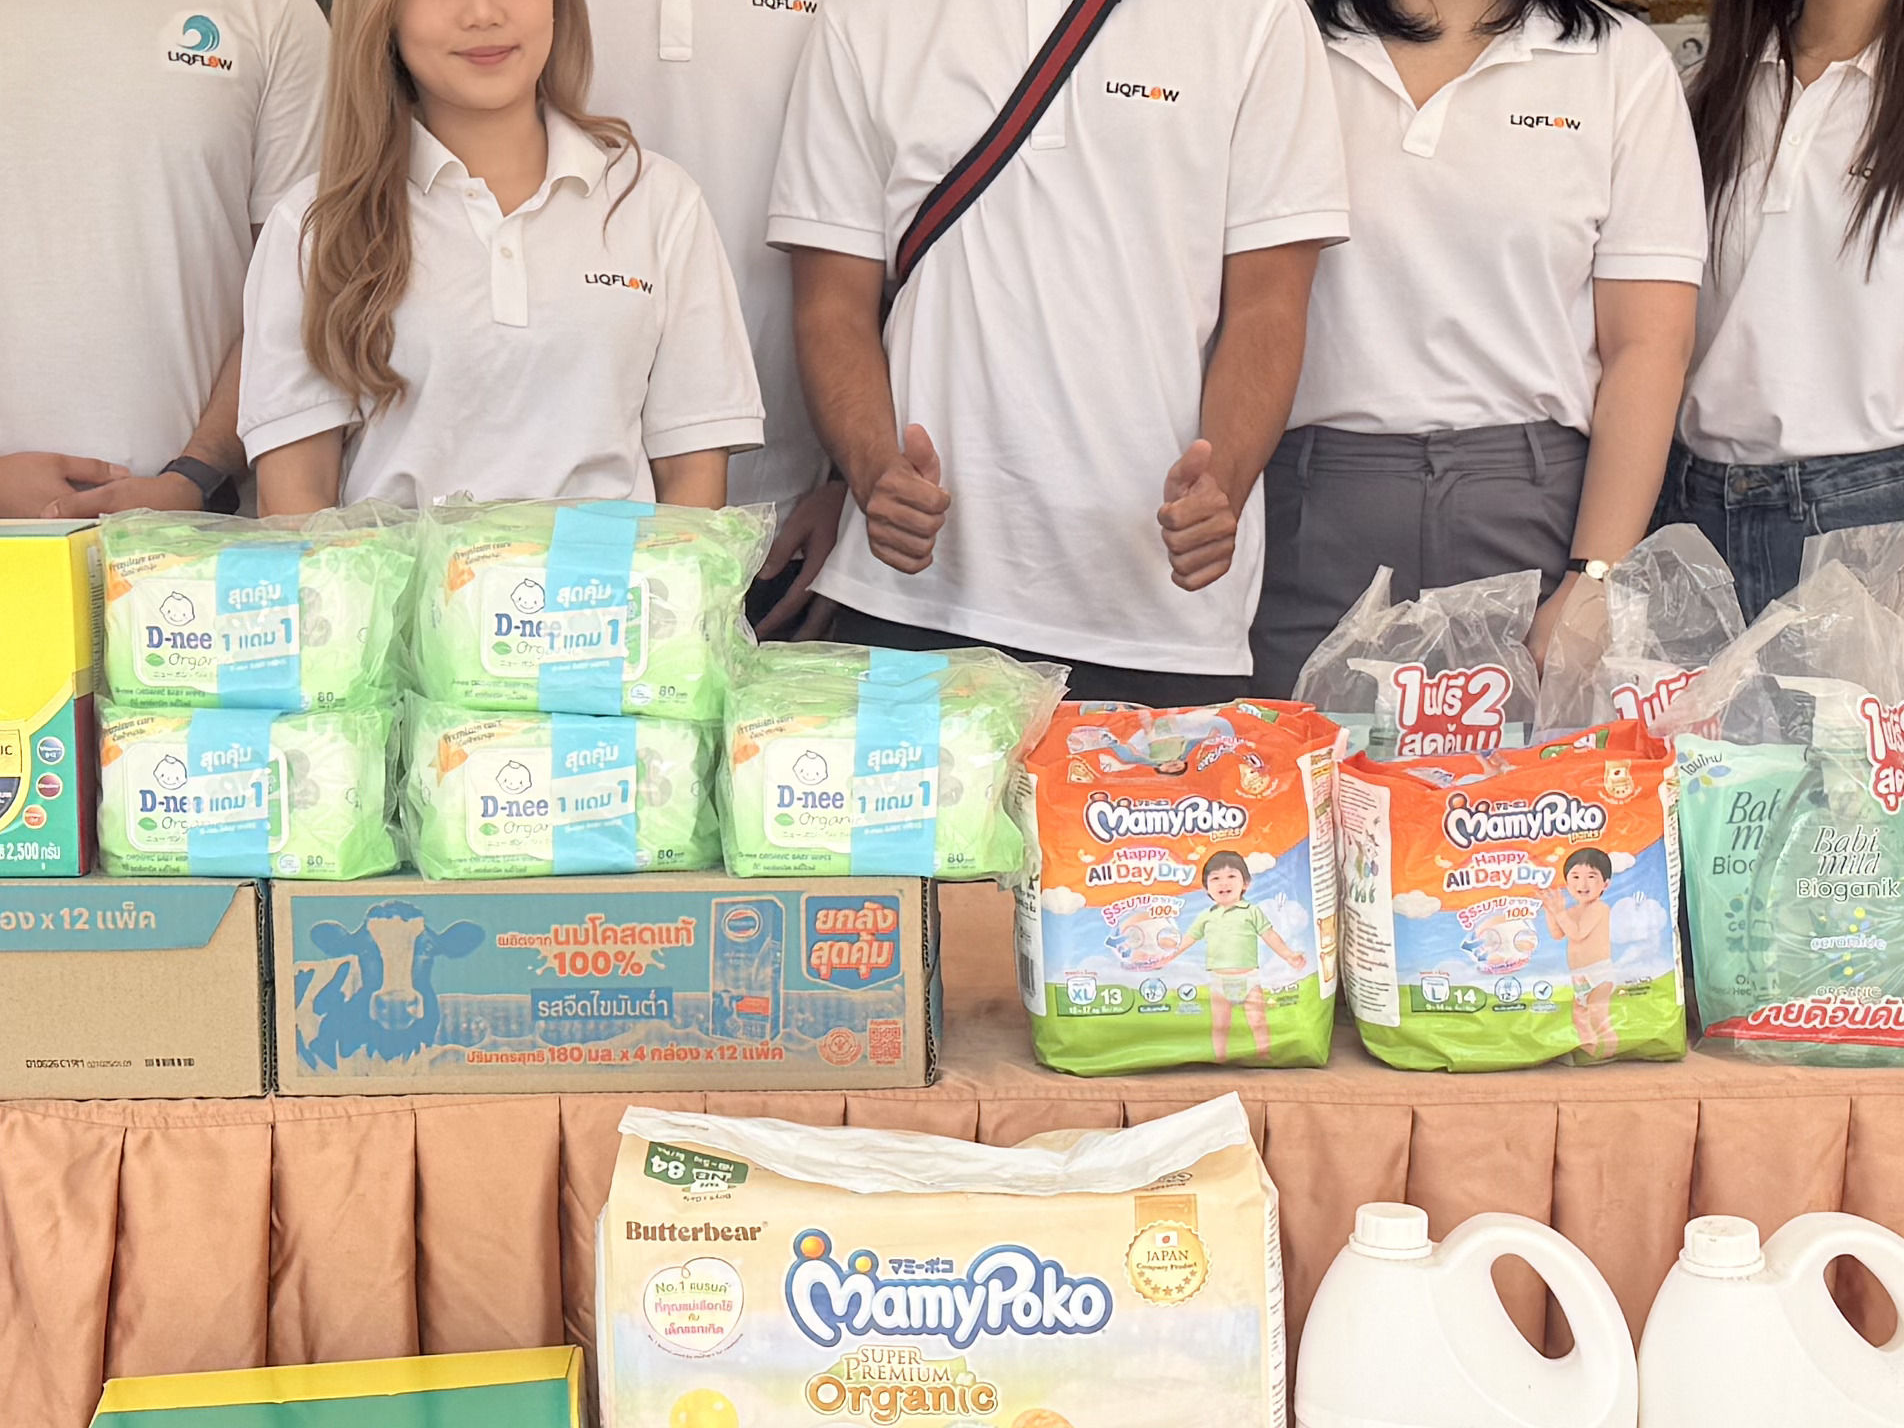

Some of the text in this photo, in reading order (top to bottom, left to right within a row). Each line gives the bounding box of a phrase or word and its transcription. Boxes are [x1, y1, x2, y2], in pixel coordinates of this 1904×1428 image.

[167, 51, 233, 71] LIQFLOW
[1106, 81, 1180, 102] LIQFLOW
[1510, 114, 1581, 131] LIQFLOW
[584, 273, 653, 295] LIQFLOW
[1085, 792, 1247, 841] MamyPoko
[1444, 792, 1606, 847] MamyPoko
[5, 840, 40, 863] 2,500
[1796, 877, 1901, 902] Bioganik
[59, 907, 89, 932] 12
[95, 900, 159, 933] แพ็ค
[624, 1220, 763, 1242] Butterbear
[1145, 1248, 1189, 1264] JAPAN
[785, 1228, 1113, 1349] MamyPoko
[860, 1346, 922, 1366] SUPER
[844, 1353, 952, 1384] PREMIUM
[806, 1375, 999, 1423] Organic
